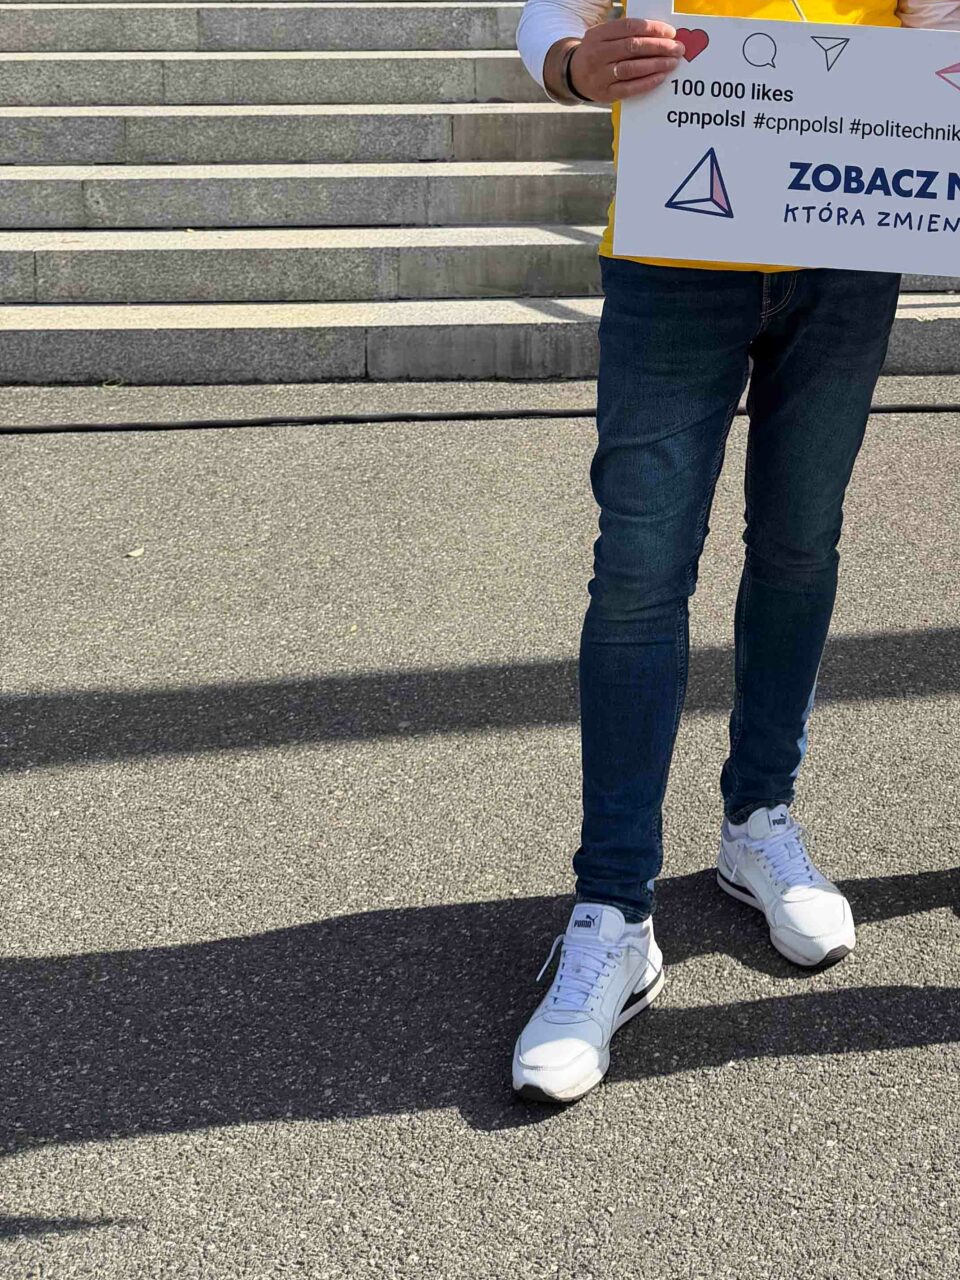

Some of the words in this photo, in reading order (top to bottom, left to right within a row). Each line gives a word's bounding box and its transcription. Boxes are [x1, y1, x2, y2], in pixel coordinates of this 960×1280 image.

[671, 78, 705, 97] 100
[710, 81, 746, 100] 000
[751, 82, 794, 103] likes
[666, 109, 746, 130] cpnpolsl
[753, 112, 843, 136] #cpnpolsl
[787, 161, 940, 200] ZOBACZ
[783, 201, 866, 227] KTÓRA
